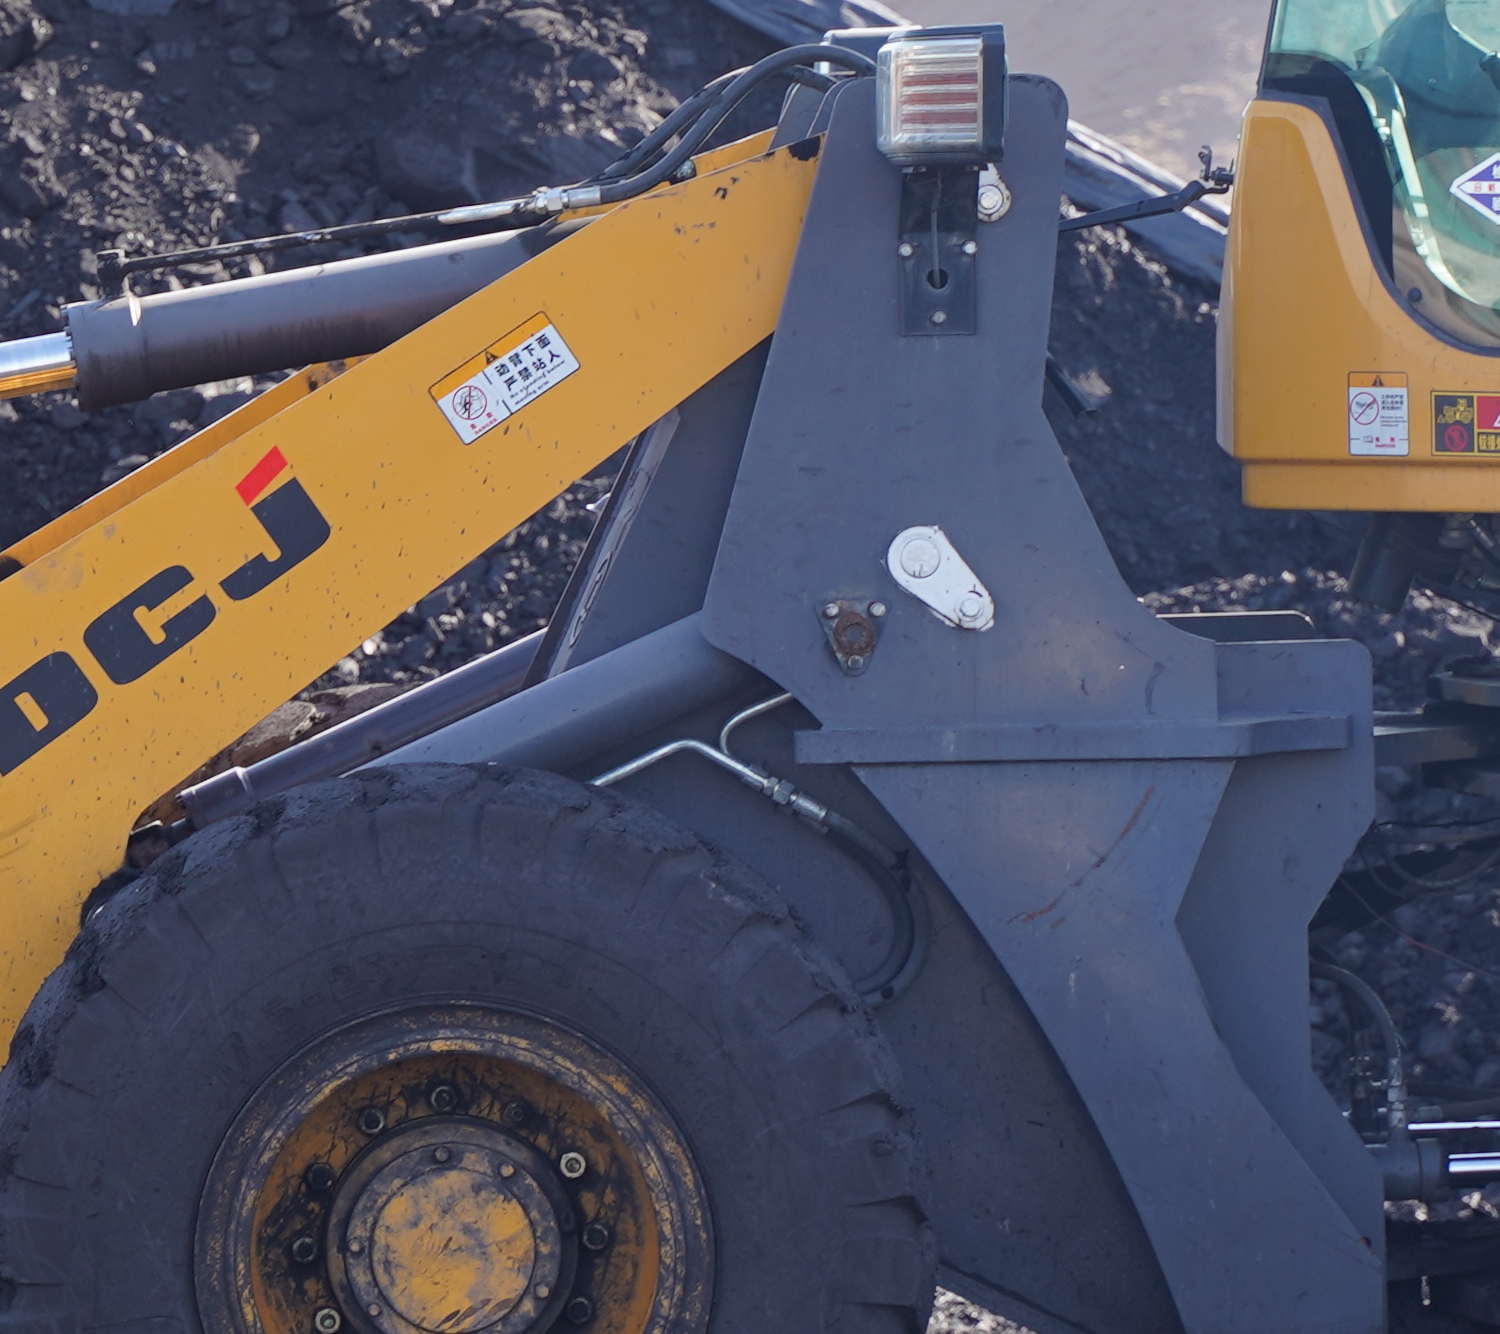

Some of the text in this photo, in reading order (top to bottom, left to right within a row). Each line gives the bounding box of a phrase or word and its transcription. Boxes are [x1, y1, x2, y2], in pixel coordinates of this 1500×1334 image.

[493, 333, 552, 377] 动臂下面
[502, 349, 560, 392] 严禁站人
